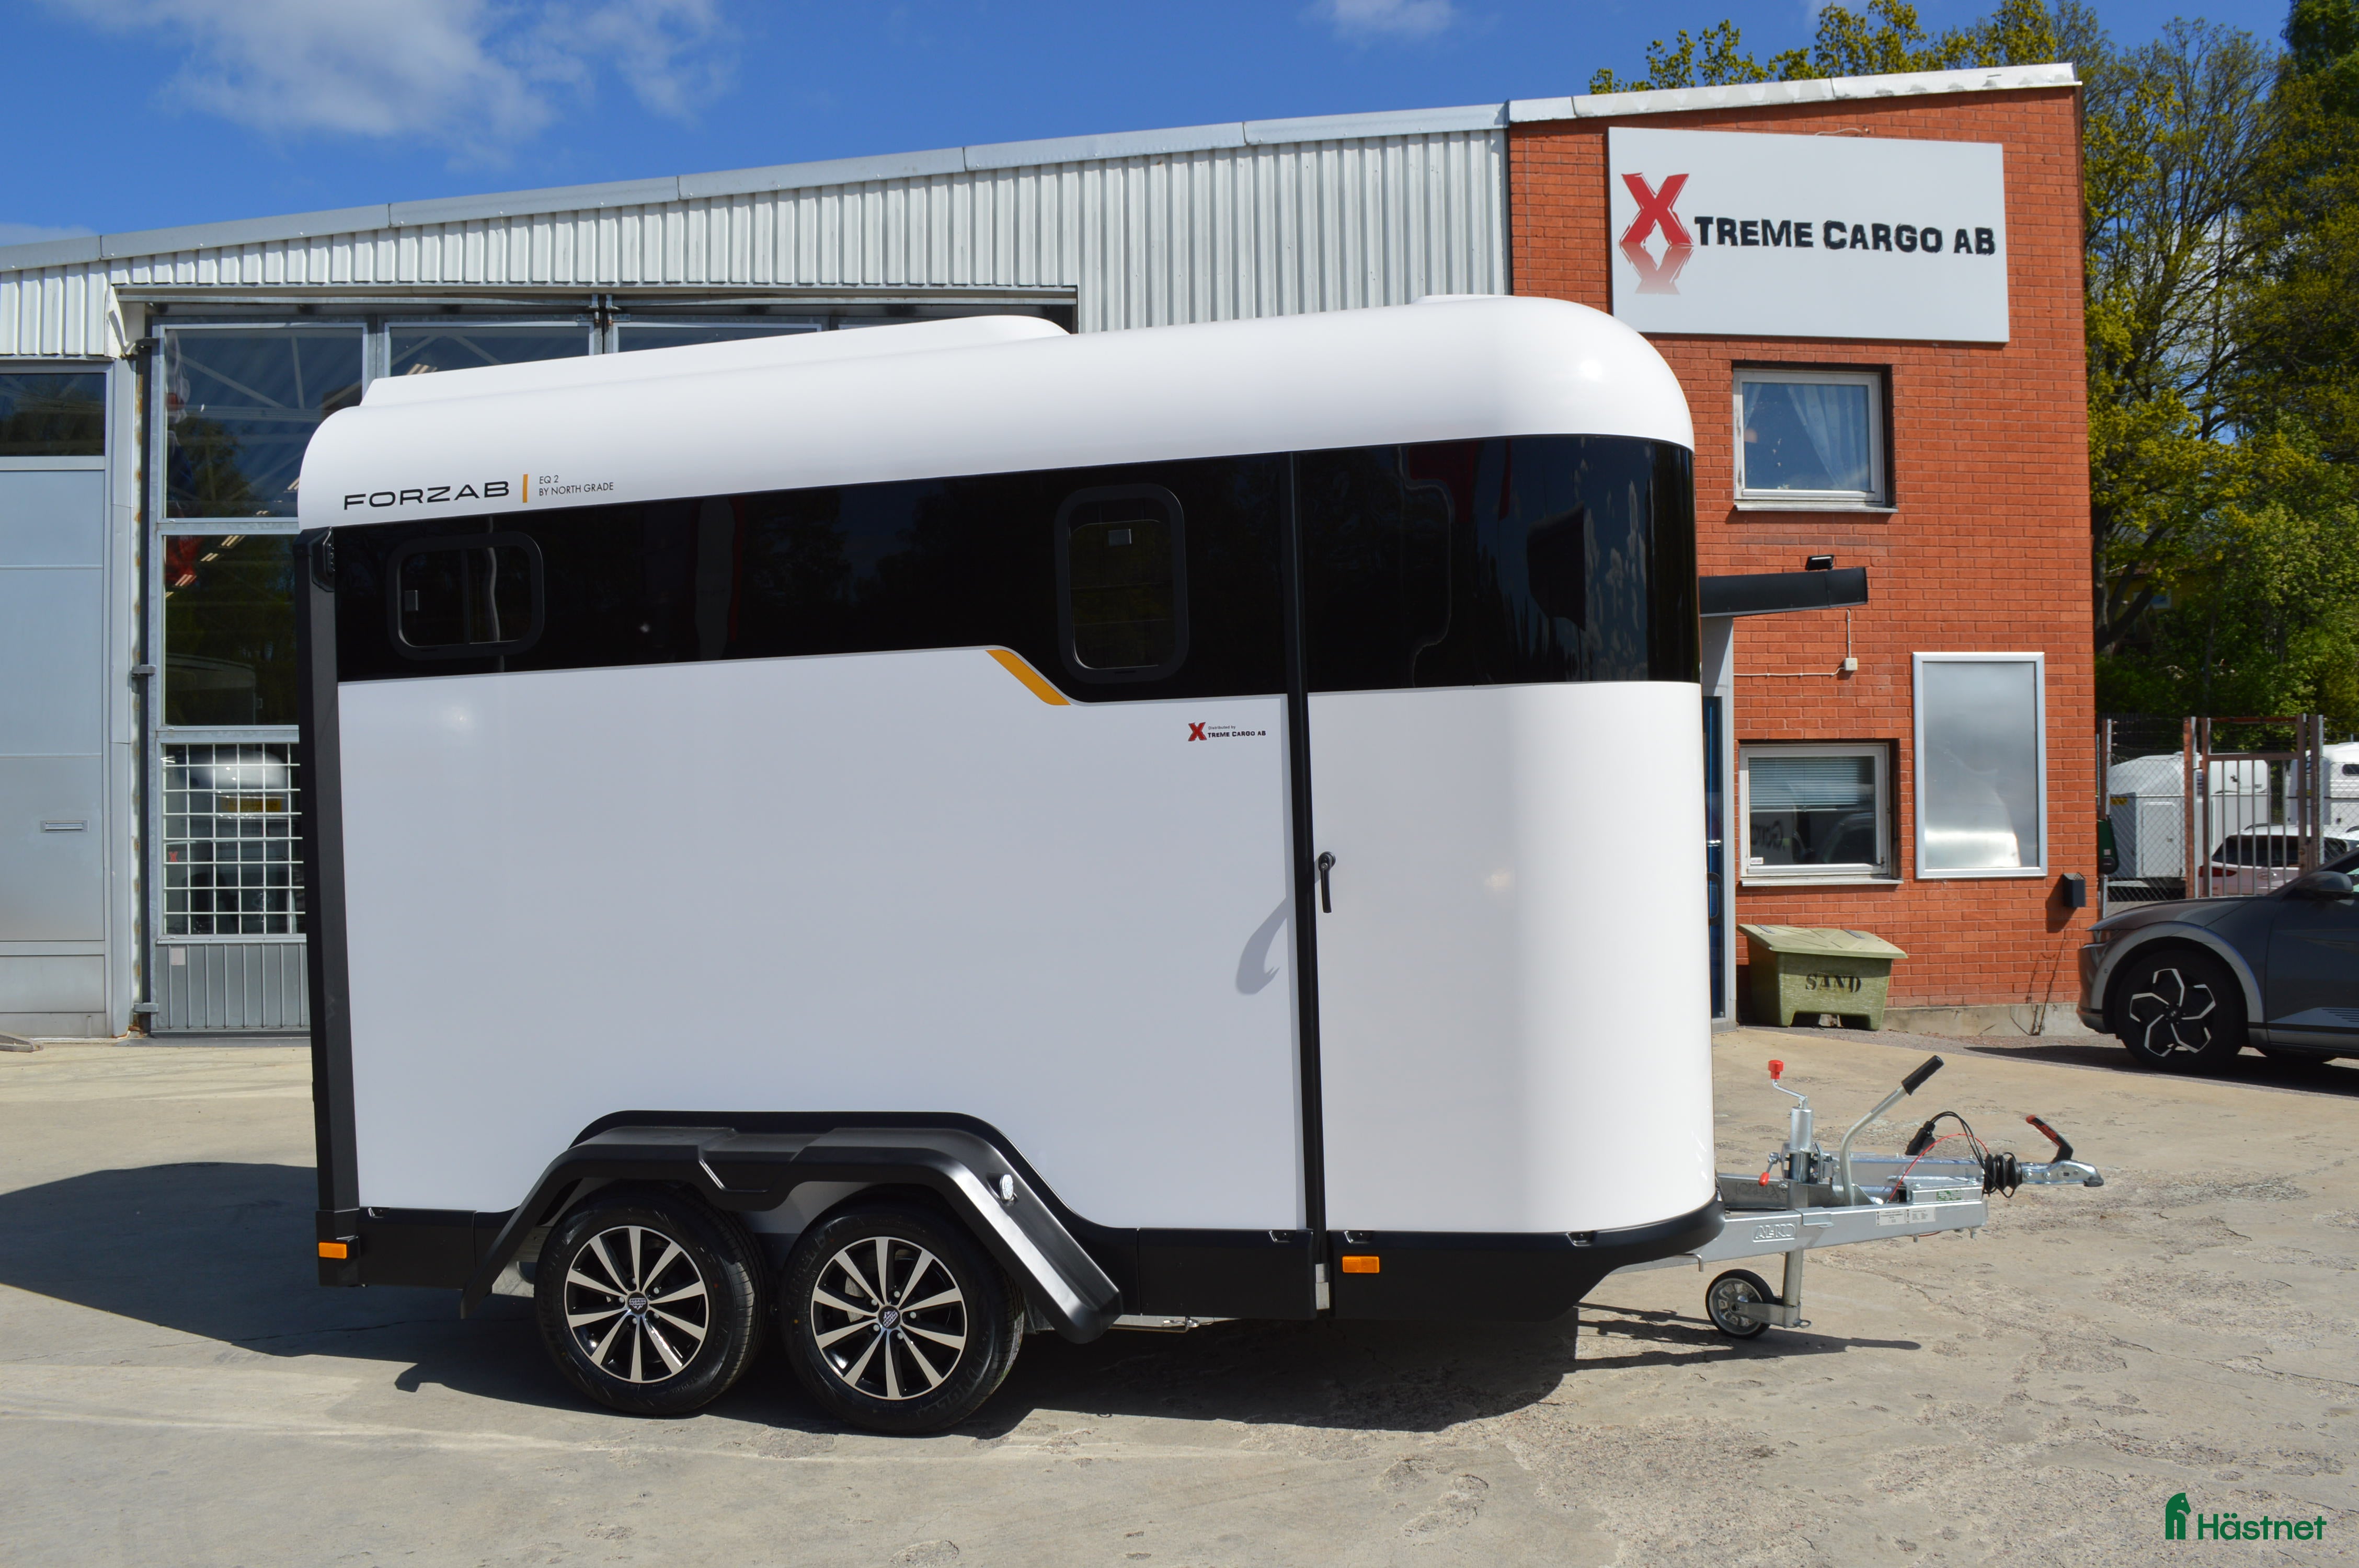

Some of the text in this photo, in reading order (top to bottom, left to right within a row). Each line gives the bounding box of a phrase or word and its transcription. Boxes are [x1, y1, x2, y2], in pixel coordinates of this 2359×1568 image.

[1822, 221, 1943, 254] CARGO
[1953, 227, 1996, 256] AB
[539, 476, 552, 485] EQ
[539, 482, 614, 497] BY NORTH GRADE
[343, 481, 510, 510] FORZAB
[1805, 973, 1861, 993] SAND
[1755, 1223, 1796, 1239] AL-KO
